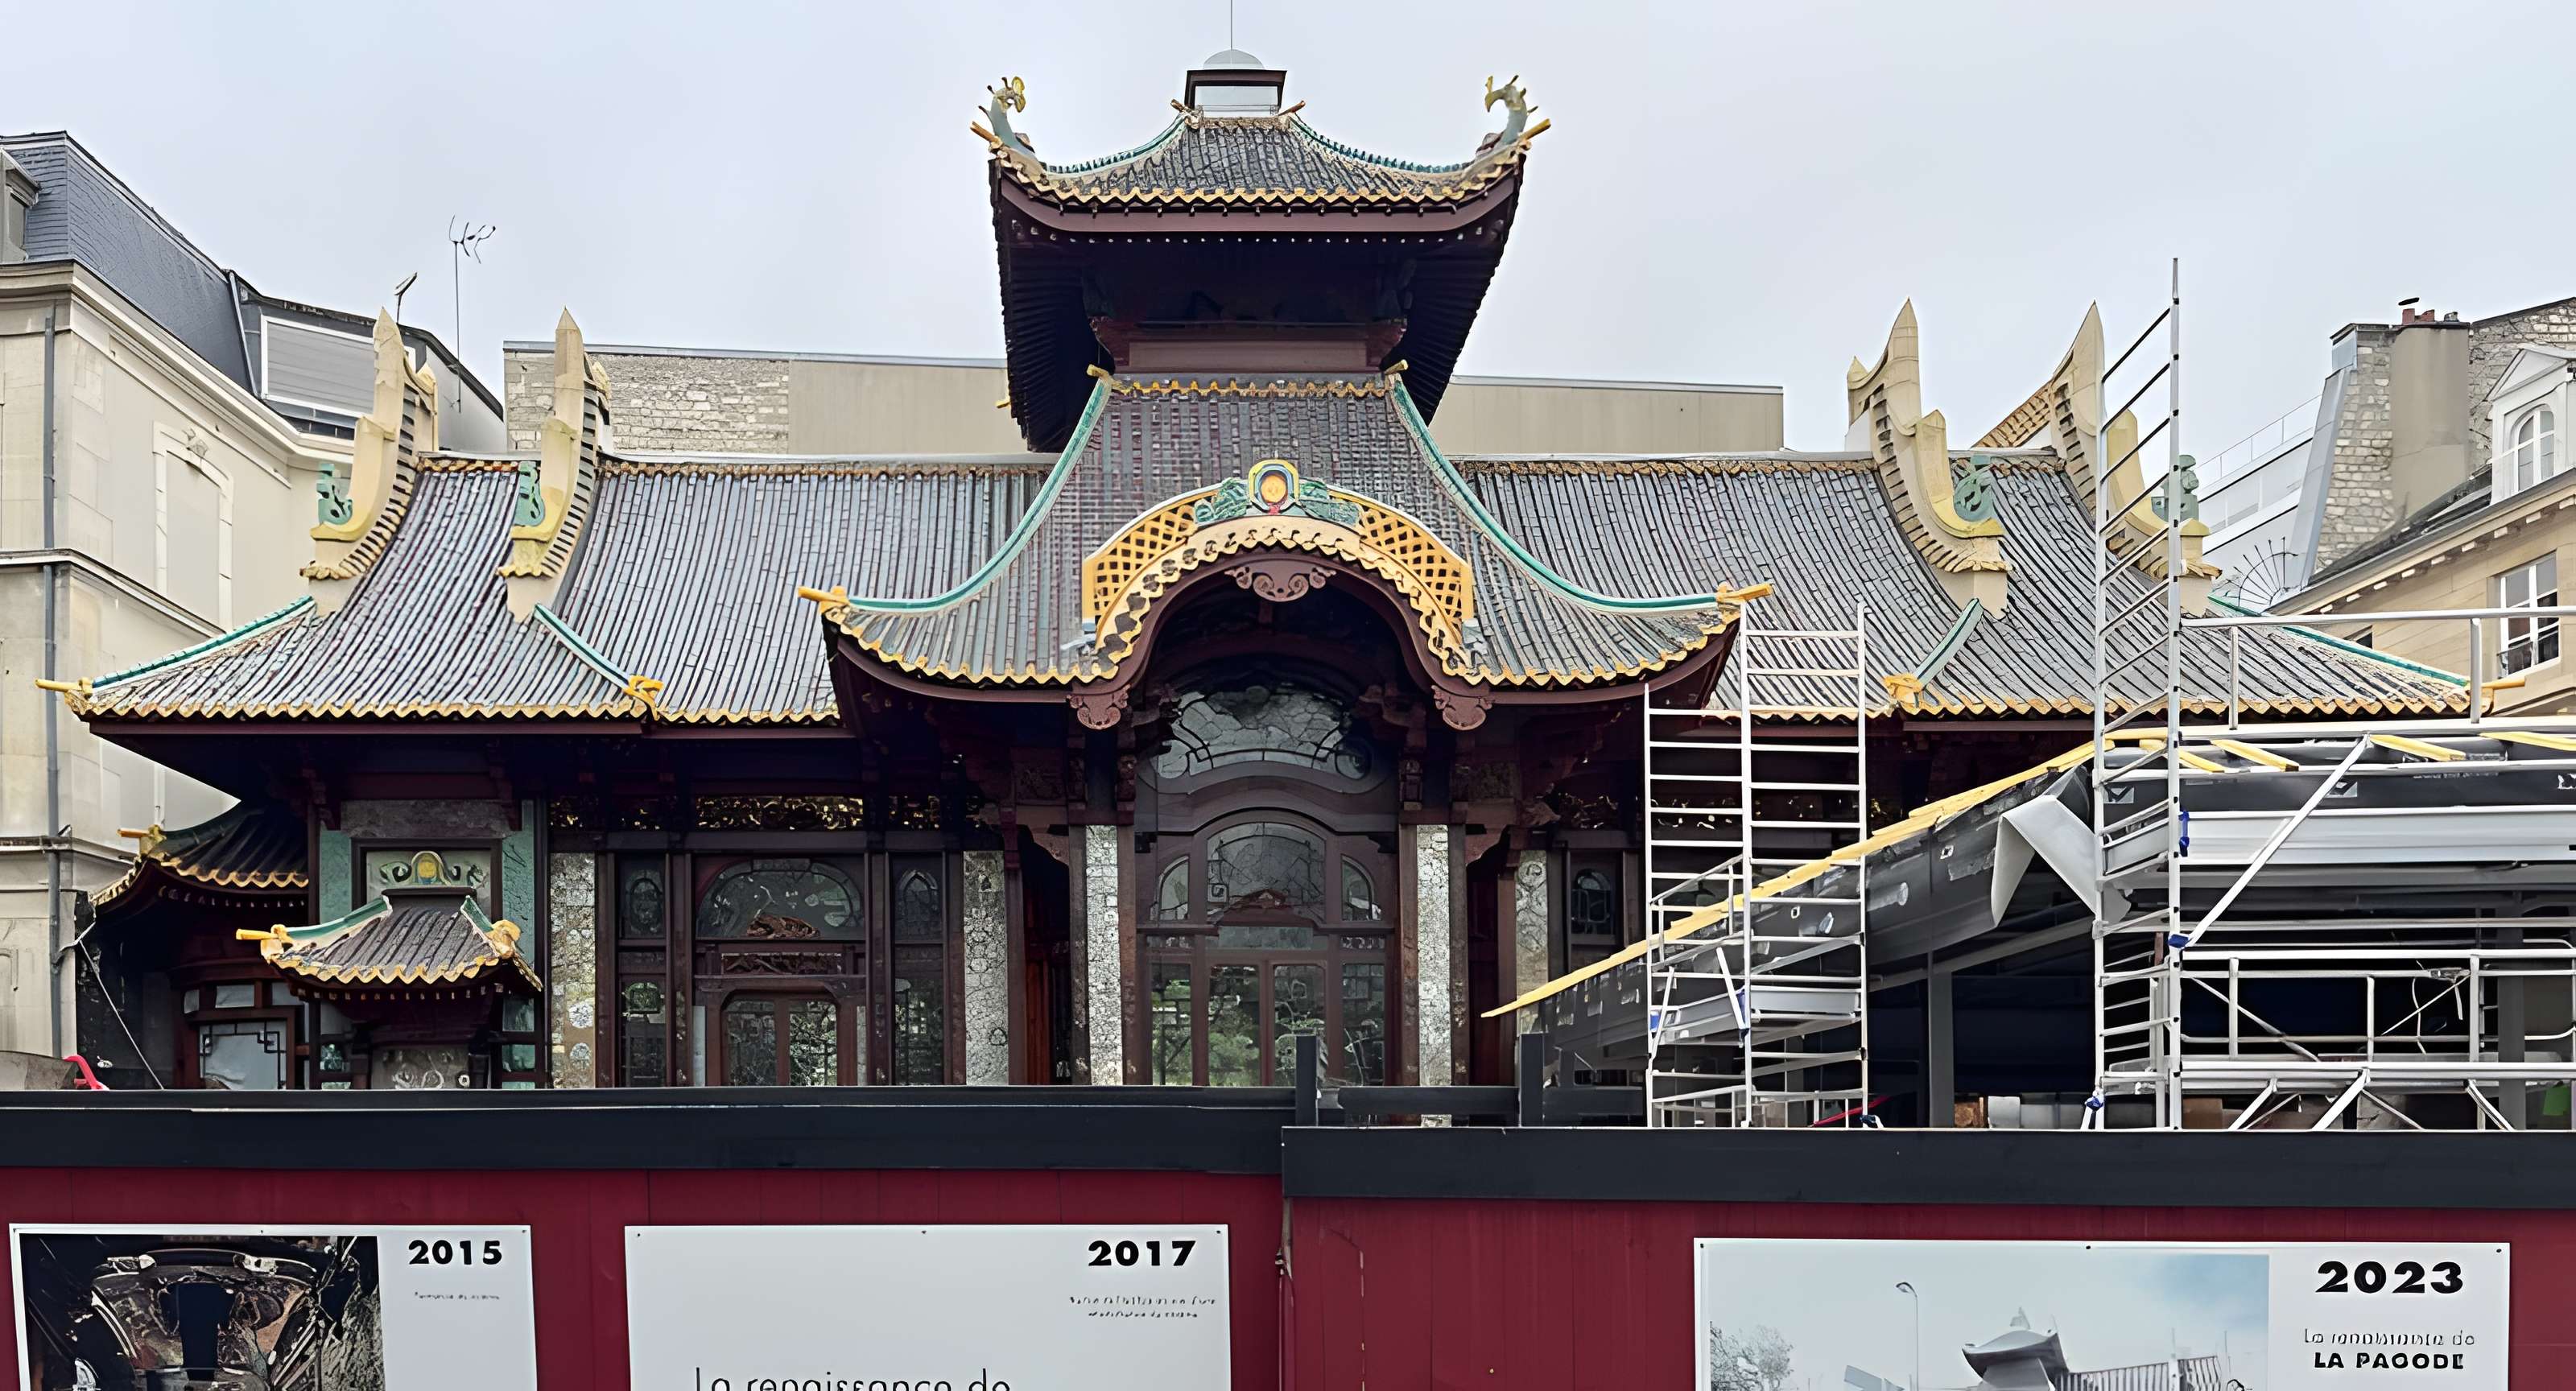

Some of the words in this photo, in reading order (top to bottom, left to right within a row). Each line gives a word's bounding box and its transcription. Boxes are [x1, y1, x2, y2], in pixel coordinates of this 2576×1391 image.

[408, 1239, 502, 1265] 2015
[1088, 1240, 1197, 1267] 2017
[2314, 1261, 2464, 1294] 2023
[2314, 1352, 2345, 1369] LA
